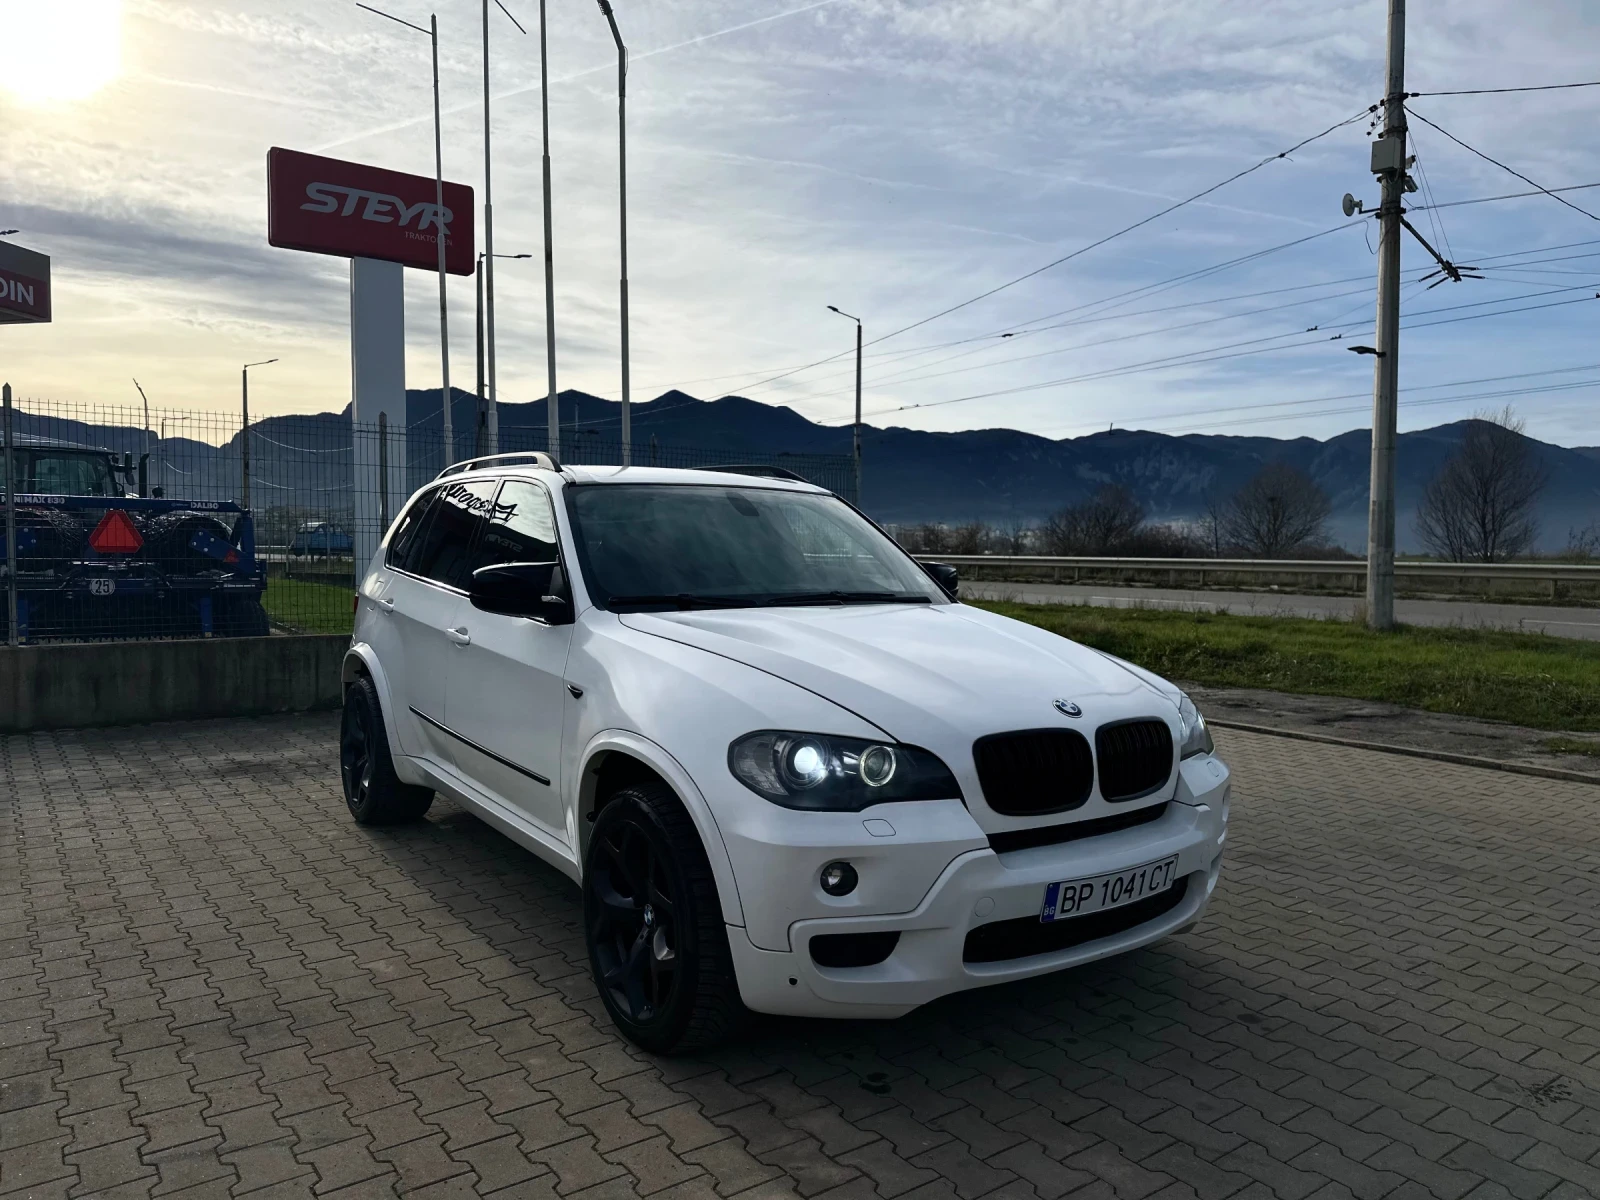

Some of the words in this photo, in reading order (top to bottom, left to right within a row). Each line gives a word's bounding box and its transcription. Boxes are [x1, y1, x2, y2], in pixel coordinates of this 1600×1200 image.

[300, 182, 453, 234] STEYR
[405, 232, 453, 246] TRAKTOEN
[190, 502, 219, 510] DALBO
[95, 580, 109, 593] 25
[1061, 884, 1094, 914] BP
[1102, 870, 1147, 906] 1041
[1149, 860, 1175, 891] CT
